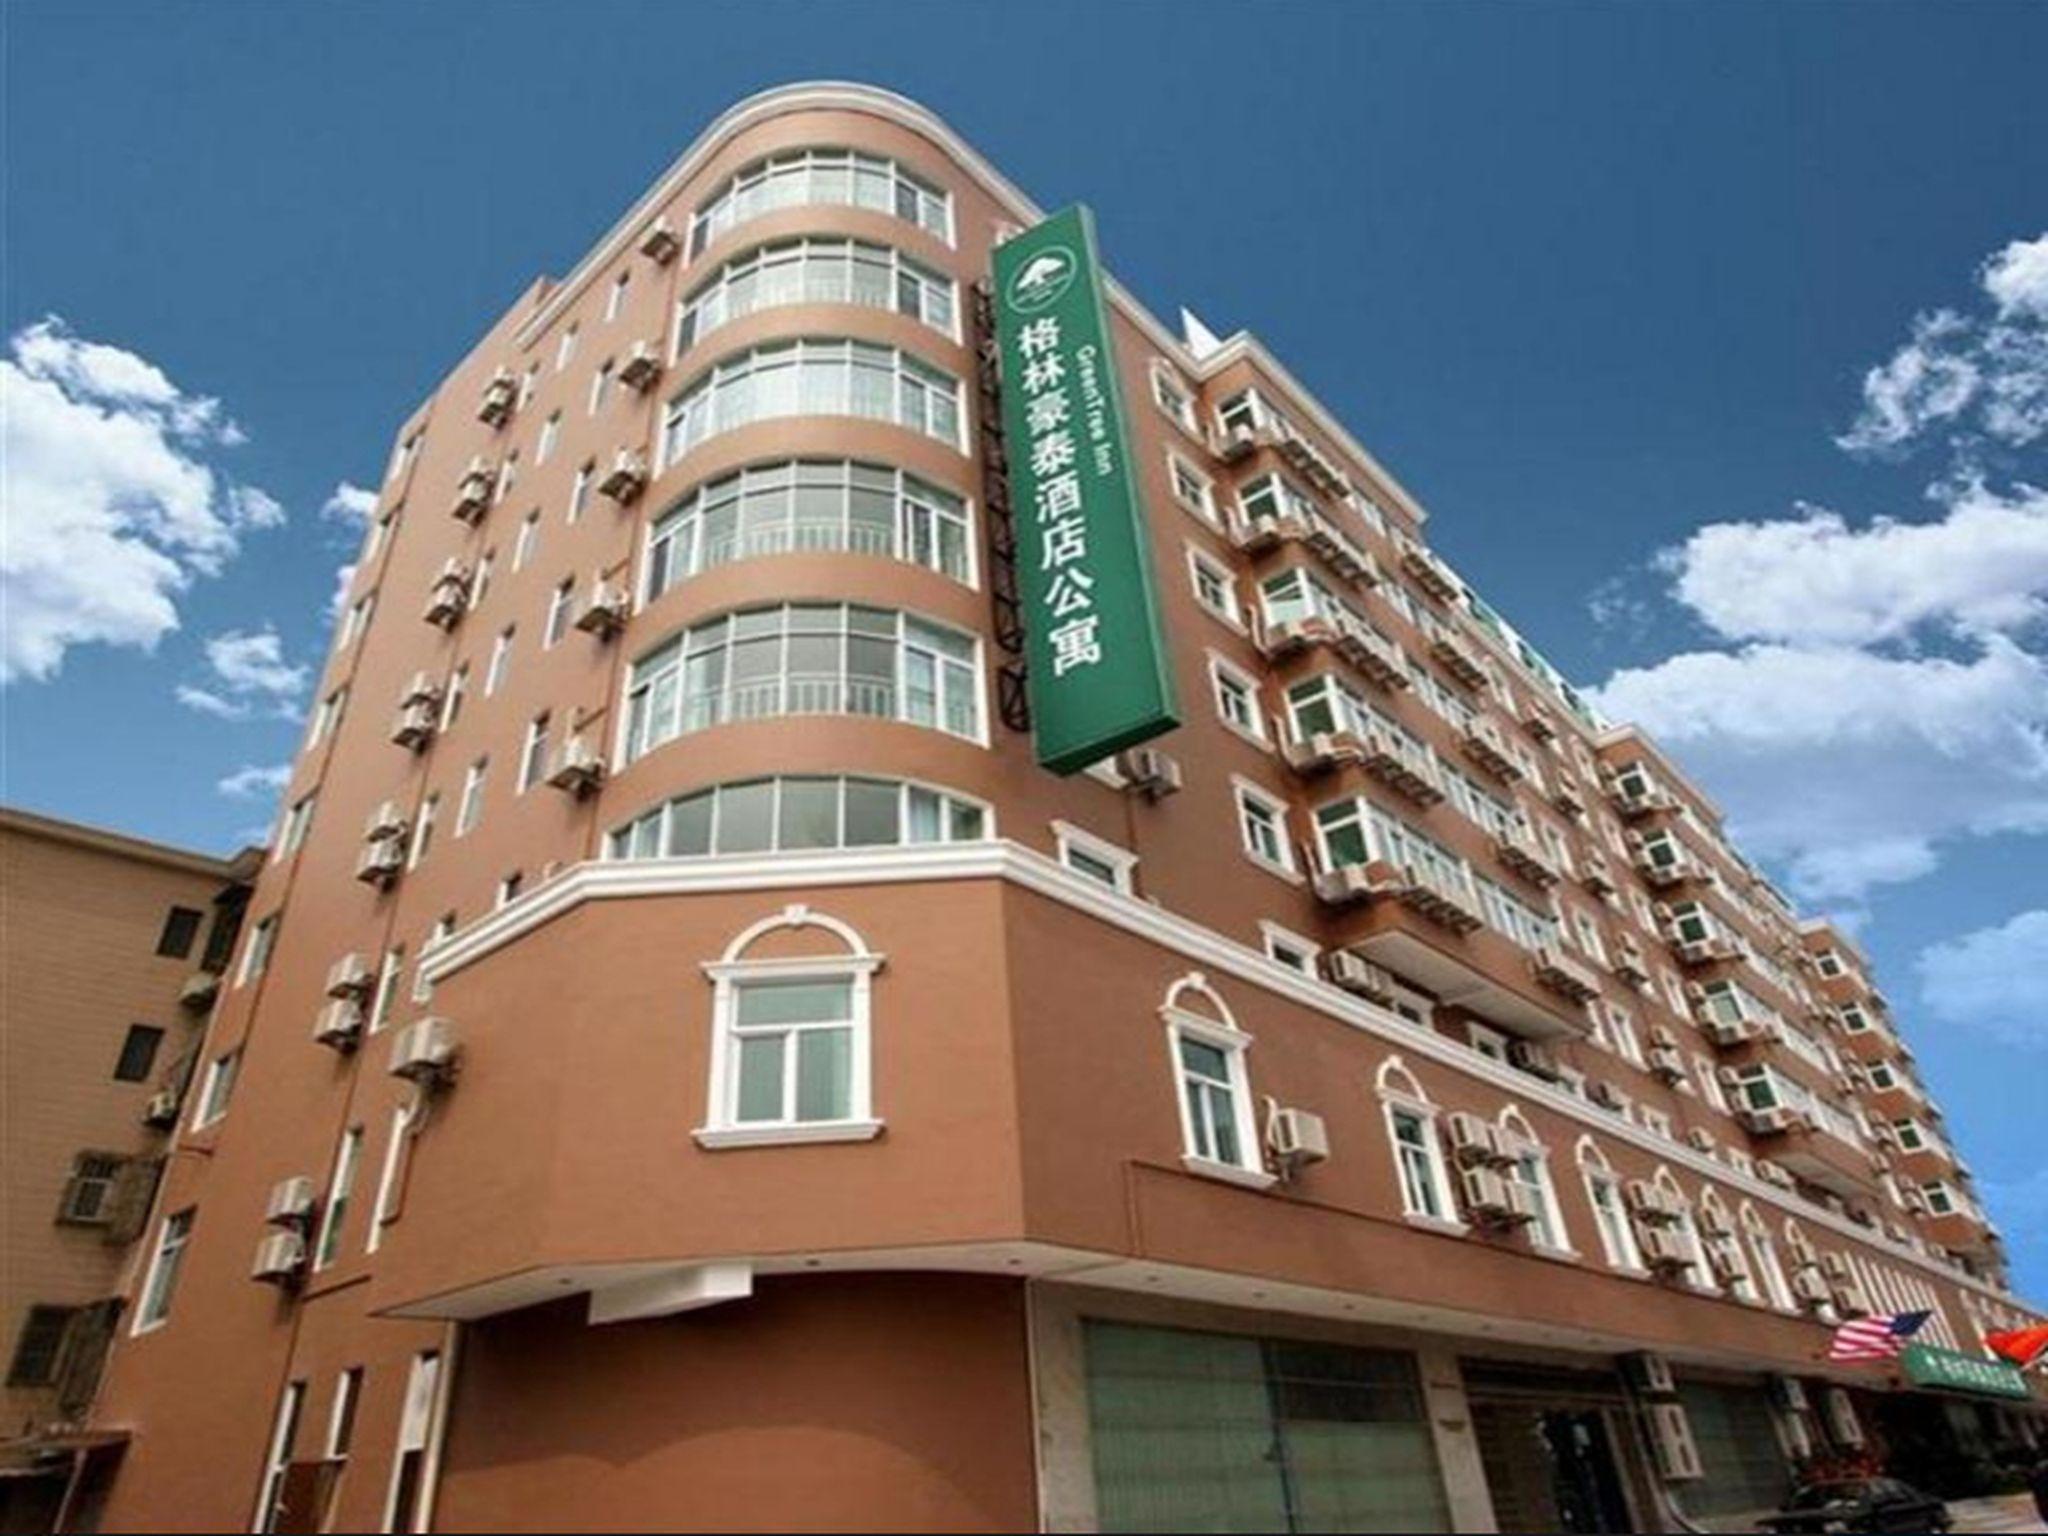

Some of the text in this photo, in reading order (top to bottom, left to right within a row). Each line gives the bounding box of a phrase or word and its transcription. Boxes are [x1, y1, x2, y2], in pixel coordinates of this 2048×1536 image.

[1017, 317, 1101, 676] 格林豪泰酒店公寓
[1095, 443, 1113, 476] Inn
